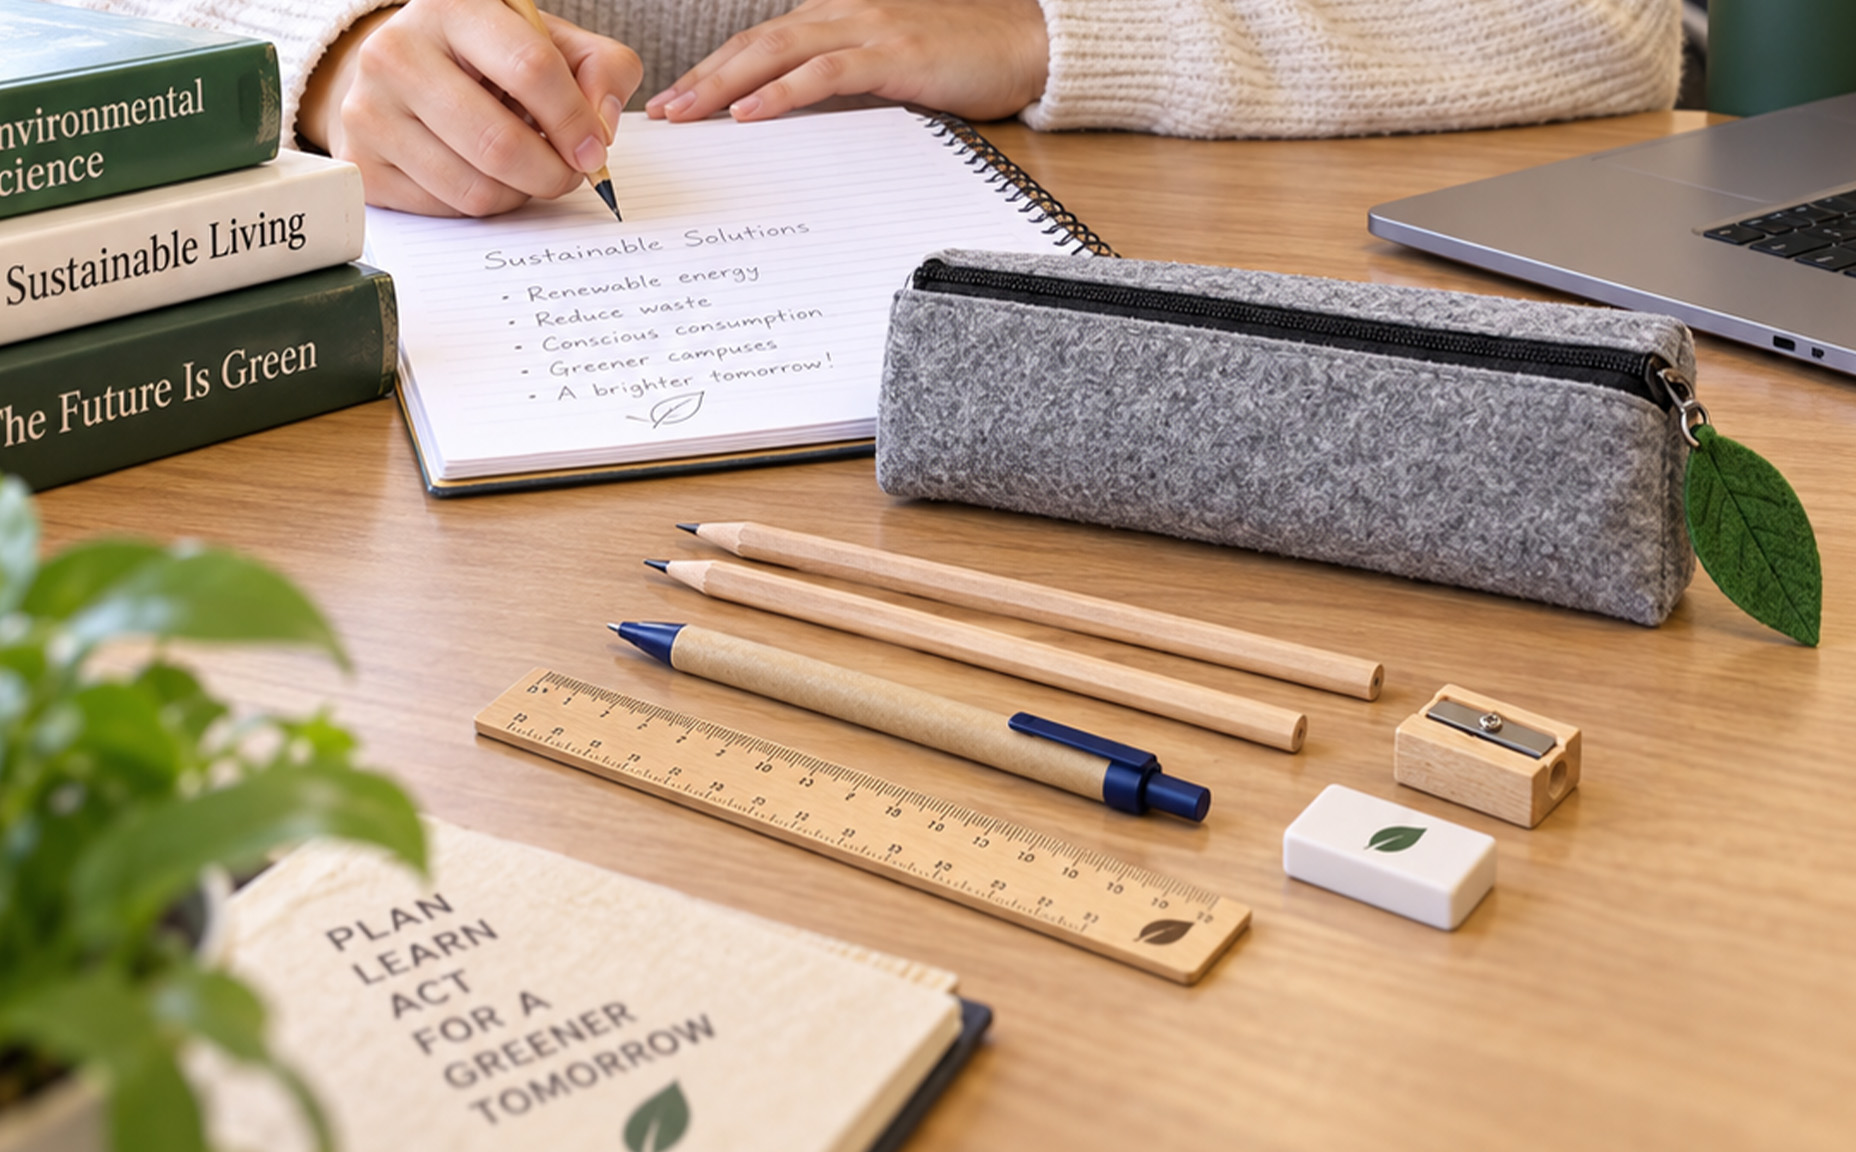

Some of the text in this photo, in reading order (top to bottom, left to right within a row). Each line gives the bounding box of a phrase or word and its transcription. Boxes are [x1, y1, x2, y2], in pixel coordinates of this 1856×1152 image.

[0, 77, 205, 150] nvironmental
[0, 152, 104, 197] cience
[6, 211, 307, 306] Sustainable Living
[484, 222, 810, 270] Sustainable Solutions
[528, 264, 760, 302] Renewable energy
[535, 295, 712, 327] Reduce waste
[543, 306, 823, 352] Conscious consumption
[549, 338, 778, 378] Greener campuses
[557, 352, 834, 401] A brighter tomorrow!
[58, 378, 172, 434] Future
[183, 362, 210, 402] Is
[221, 341, 318, 390] Green
[325, 892, 455, 952] PLAN
[352, 918, 499, 986] LEARN
[390, 969, 473, 1020] ACT
[411, 990, 553, 1056] FOR A
[443, 1000, 638, 1091] GREENER
[469, 1012, 717, 1127] TOMORROW
